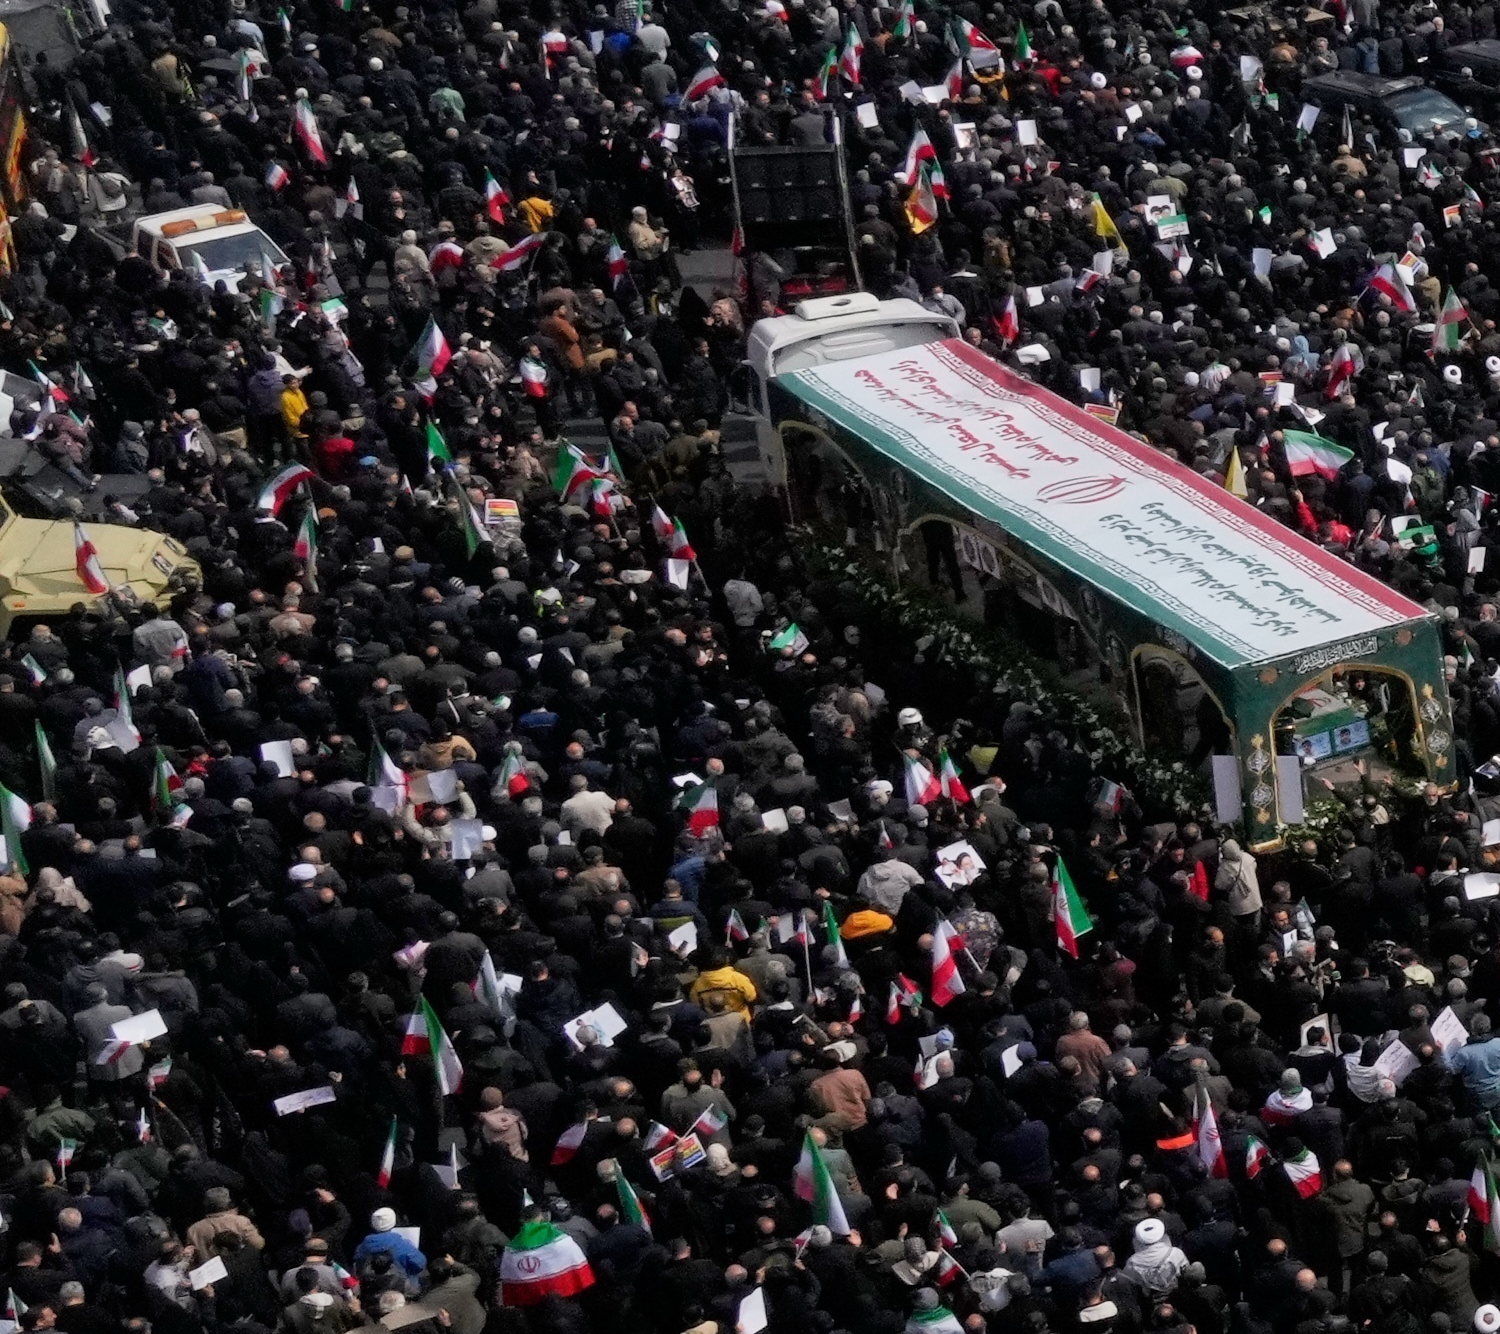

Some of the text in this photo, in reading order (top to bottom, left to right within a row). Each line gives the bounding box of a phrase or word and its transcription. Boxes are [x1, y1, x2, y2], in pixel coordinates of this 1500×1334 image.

[854, 369, 885, 389] همه
[947, 424, 996, 452] متعال
[989, 423, 1043, 442] نظام
[971, 452, 1031, 480] نصرت
[1014, 441, 1080, 466] اسلامی
[1101, 519, 1142, 533] زیر
[1134, 548, 1193, 565] قرآن
[1176, 567, 1238, 590] اسلام
[1207, 590, 1280, 625] تضمین
[1250, 616, 1299, 637] کرده
[1146, 509, 1182, 528] ملت
[1164, 525, 1216, 543] ایران
[1201, 543, 1238, 562] حتما
[1228, 554, 1279, 580] پیروز
[1255, 579, 1317, 610] خواهد
[1301, 608, 1343, 624] شد
